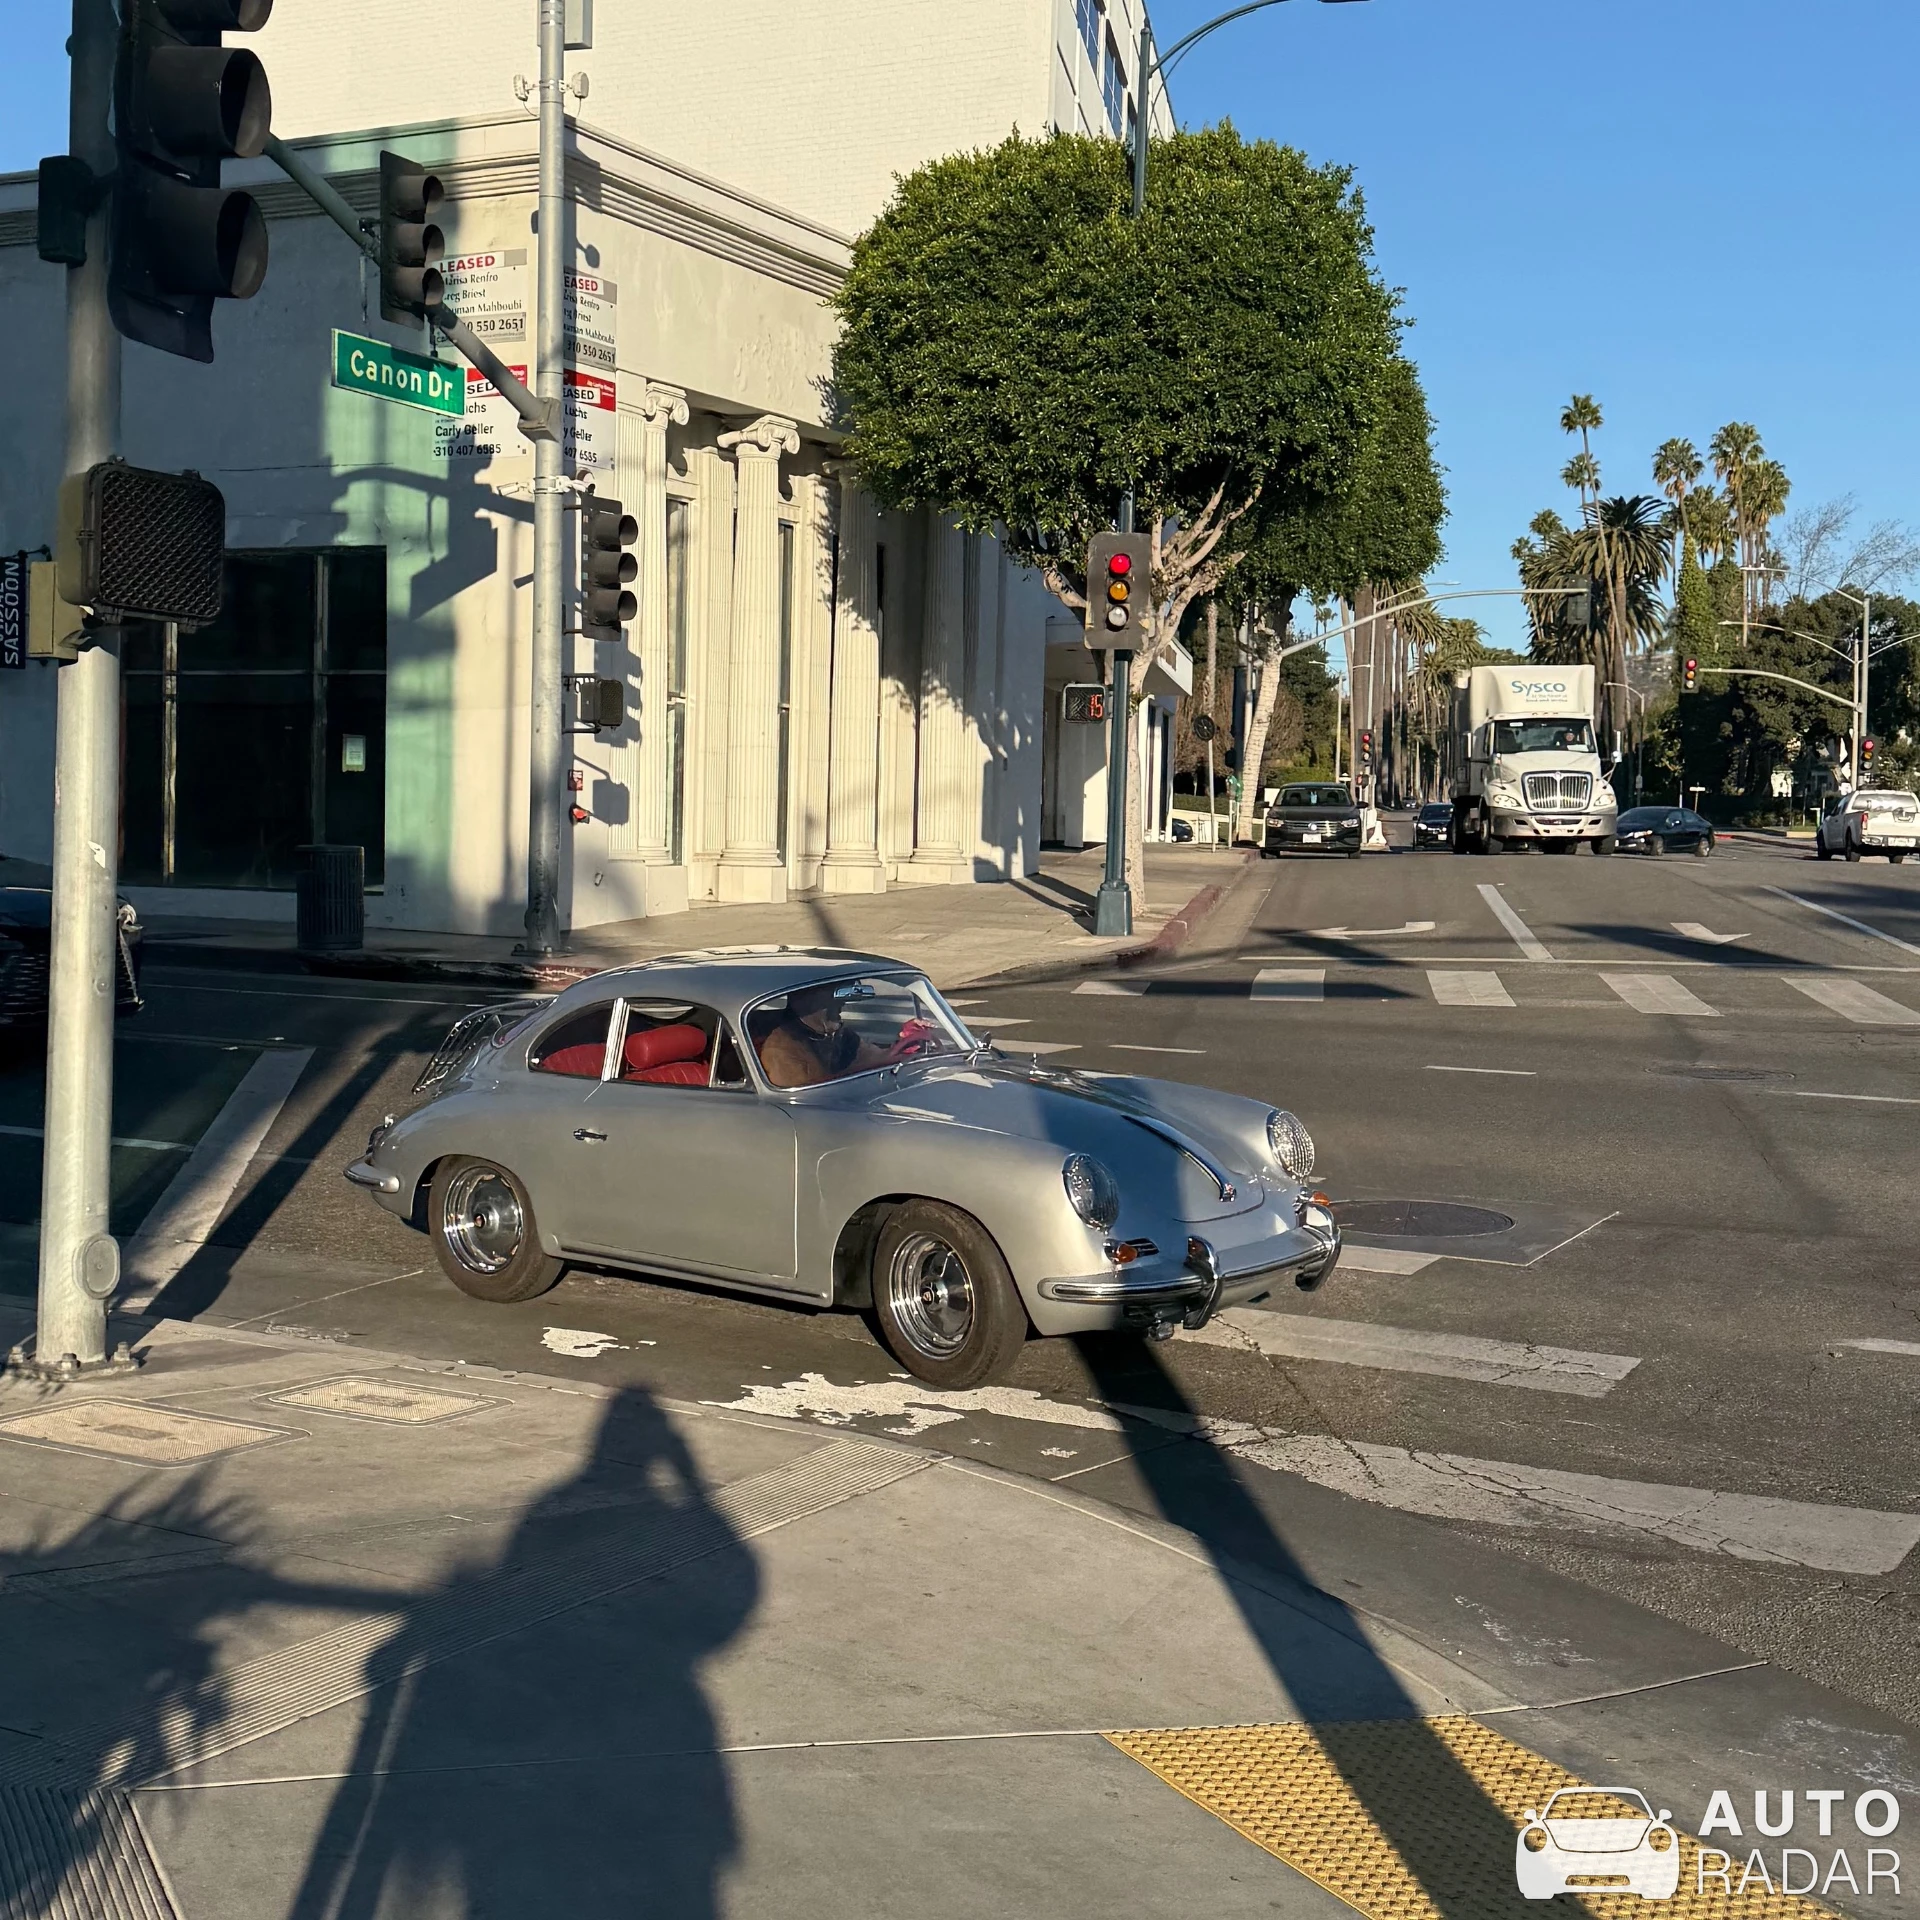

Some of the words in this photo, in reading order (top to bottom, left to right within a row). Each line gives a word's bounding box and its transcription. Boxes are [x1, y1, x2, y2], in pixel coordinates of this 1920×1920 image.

[440, 255, 496, 273] LEASED
[470, 272, 499, 284] Renfro
[563, 276, 599, 292] EASED
[462, 289, 486, 300] Briest
[452, 307, 475, 315] uman
[477, 300, 522, 312] Mahboubi
[476, 320, 496, 332] 550
[498, 318, 524, 331] 2651
[583, 344, 597, 358] 550
[598, 348, 616, 364] 2651
[350, 349, 422, 393] Canon
[428, 371, 453, 401] Dr
[466, 382, 496, 395] SED
[563, 387, 595, 400] EASED
[435, 424, 462, 439] Carly
[464, 423, 494, 435] Geller
[569, 426, 593, 442] Geller
[435, 446, 454, 456] 310
[456, 444, 474, 456] 407
[476, 443, 502, 454] 6585
[579, 449, 598, 464] 6585
[4, 561, 20, 665] SASSOON
[1511, 680, 1567, 696] Sysco
[1090, 694, 1103, 718] 15
